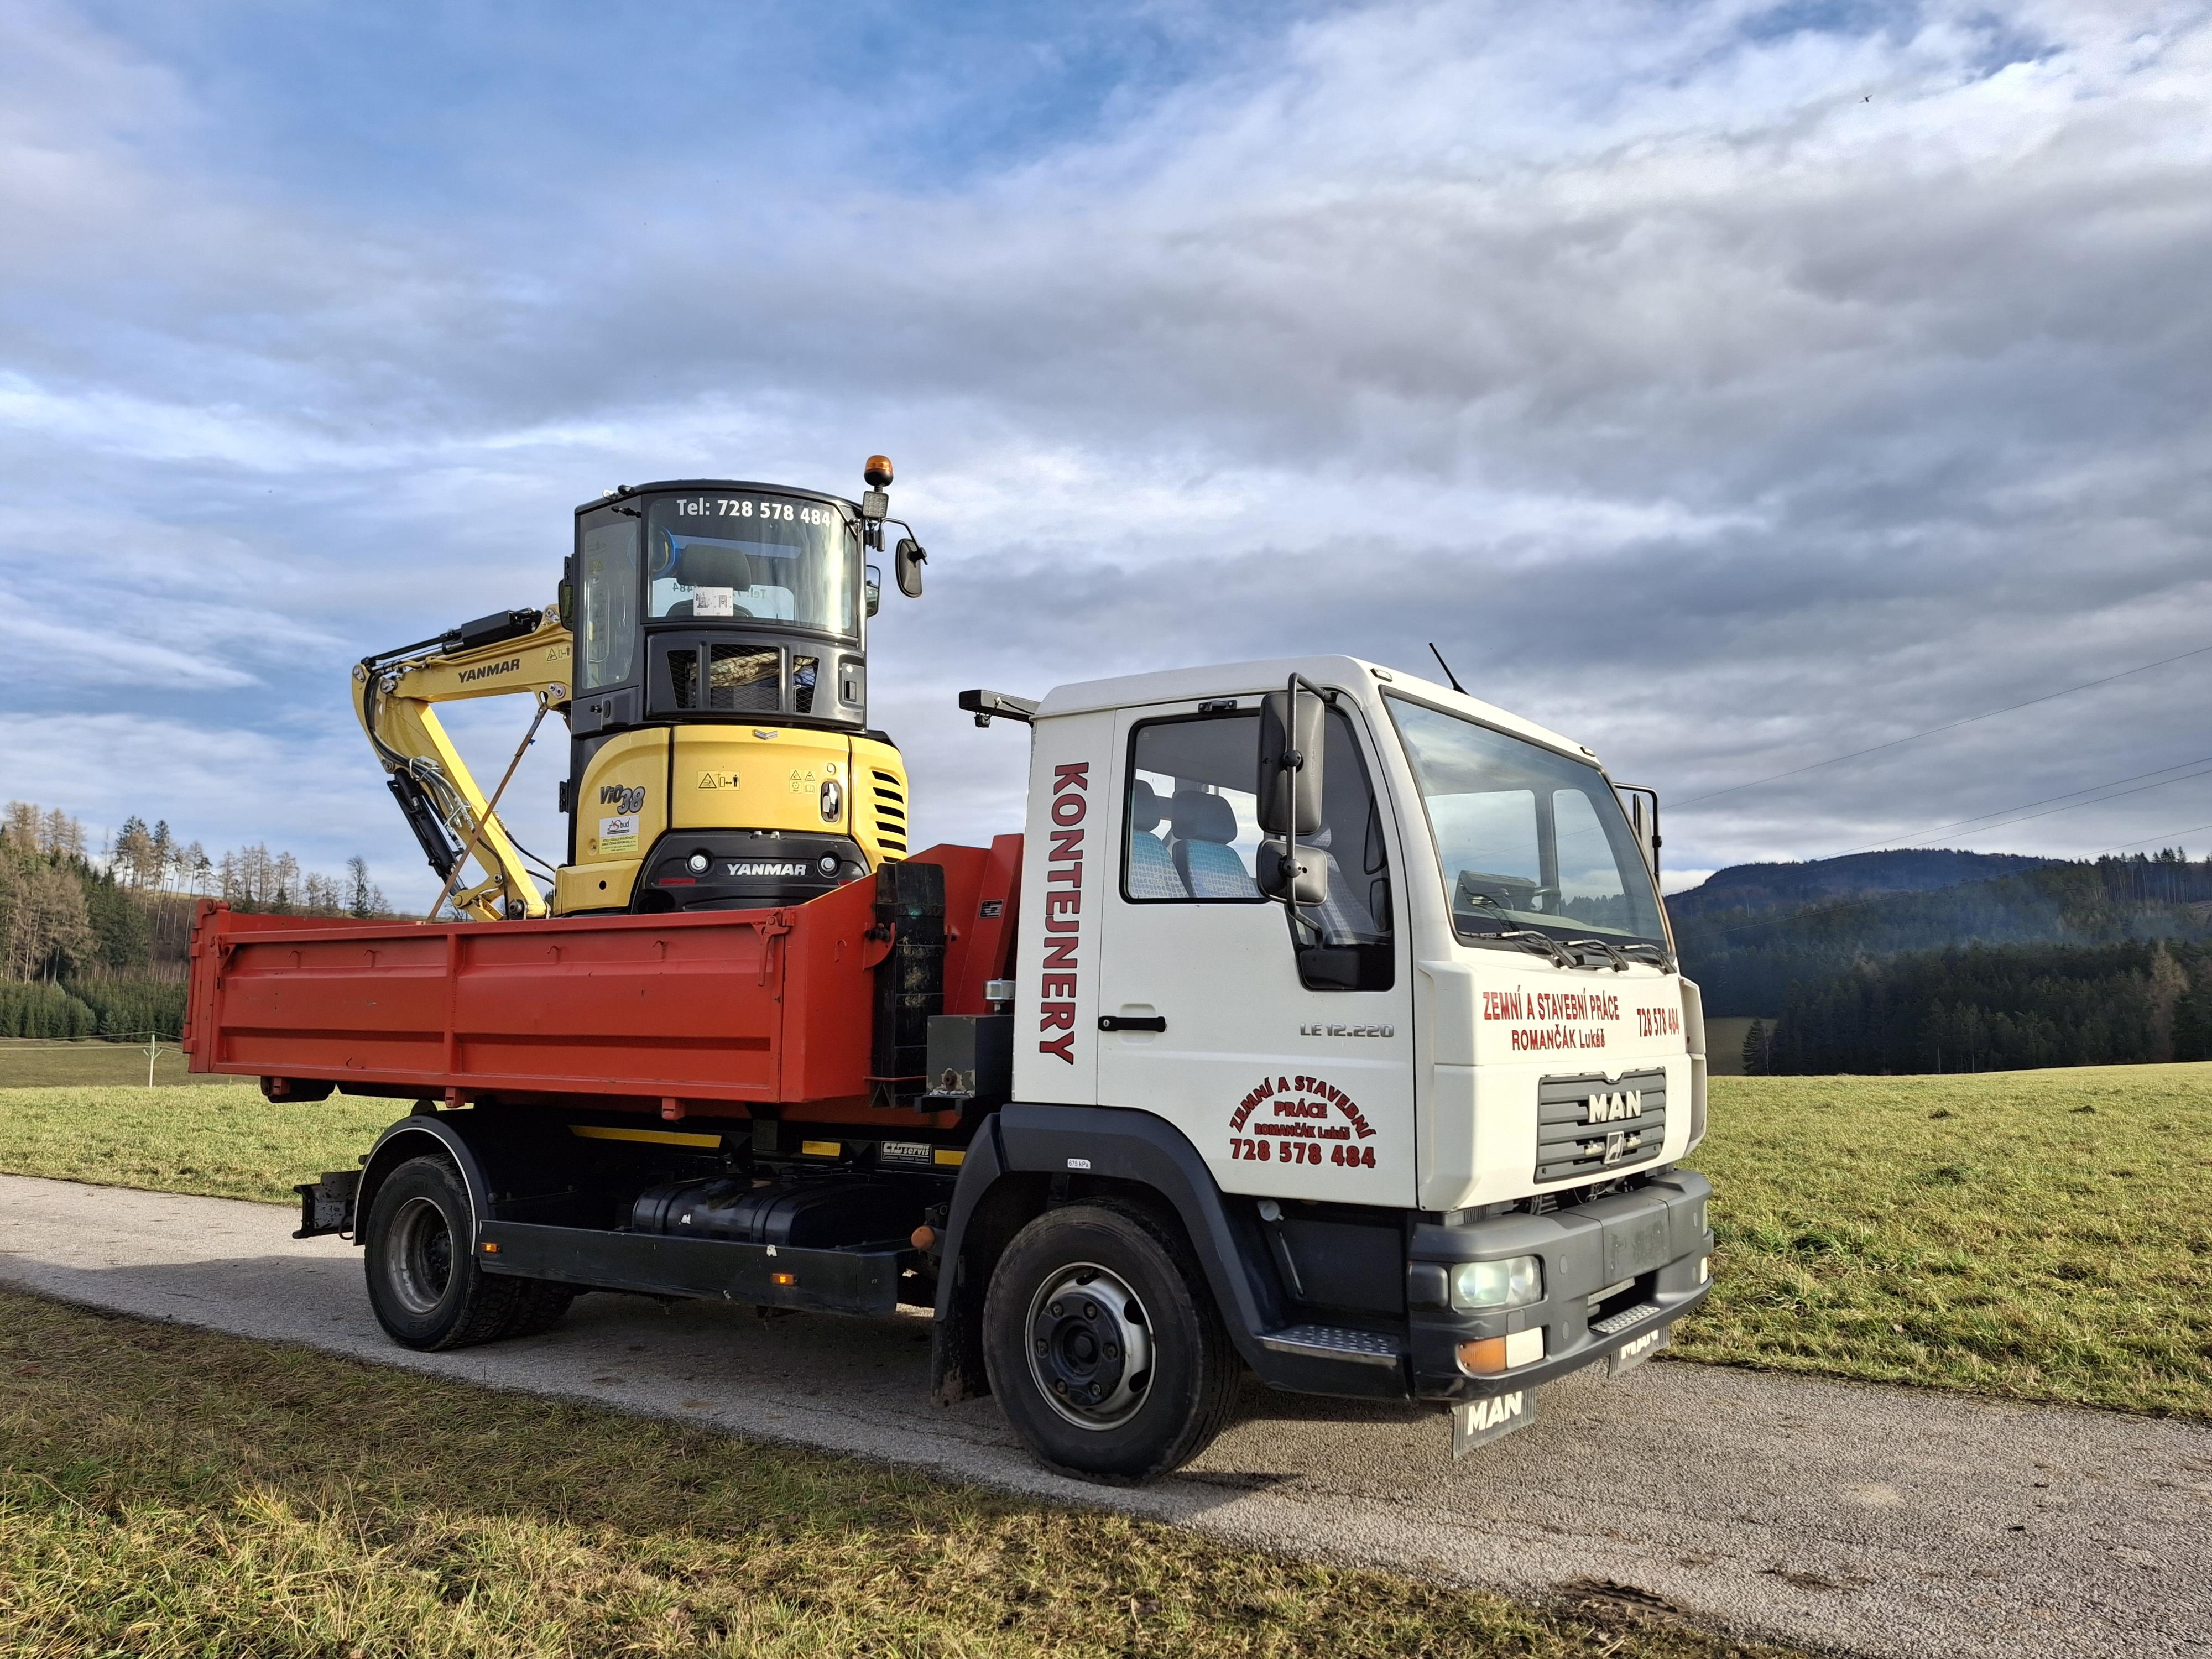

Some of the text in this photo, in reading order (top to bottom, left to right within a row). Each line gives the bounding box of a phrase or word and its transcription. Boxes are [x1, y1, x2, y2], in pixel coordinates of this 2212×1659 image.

[676, 497, 831, 527] Tel: 728 578 484
[458, 658, 520, 683] YANMAR
[727, 864, 806, 875] YANMAR
[1039, 762, 1089, 1065] KONTEJNERY
[1483, 984, 1620, 1020] ZEMNÍ A STAVEBNÍ PRÁCE
[1300, 1022, 1394, 1037] LE 12.220
[1511, 1024, 1605, 1050] ROMANČÁK Lukáš
[1637, 1008, 1679, 1037] 728 578 484
[1229, 1075, 1376, 1139] ZEMNÍ A STAVEBNÍ
[1274, 1098, 1327, 1118] PRÁCE
[1589, 1090, 1641, 1123] MAN
[1254, 1122, 1350, 1140] ROMANČÁK Lukáš
[1230, 1138, 1376, 1168] 728 578 484
[1468, 1391, 1522, 1436] MAN
